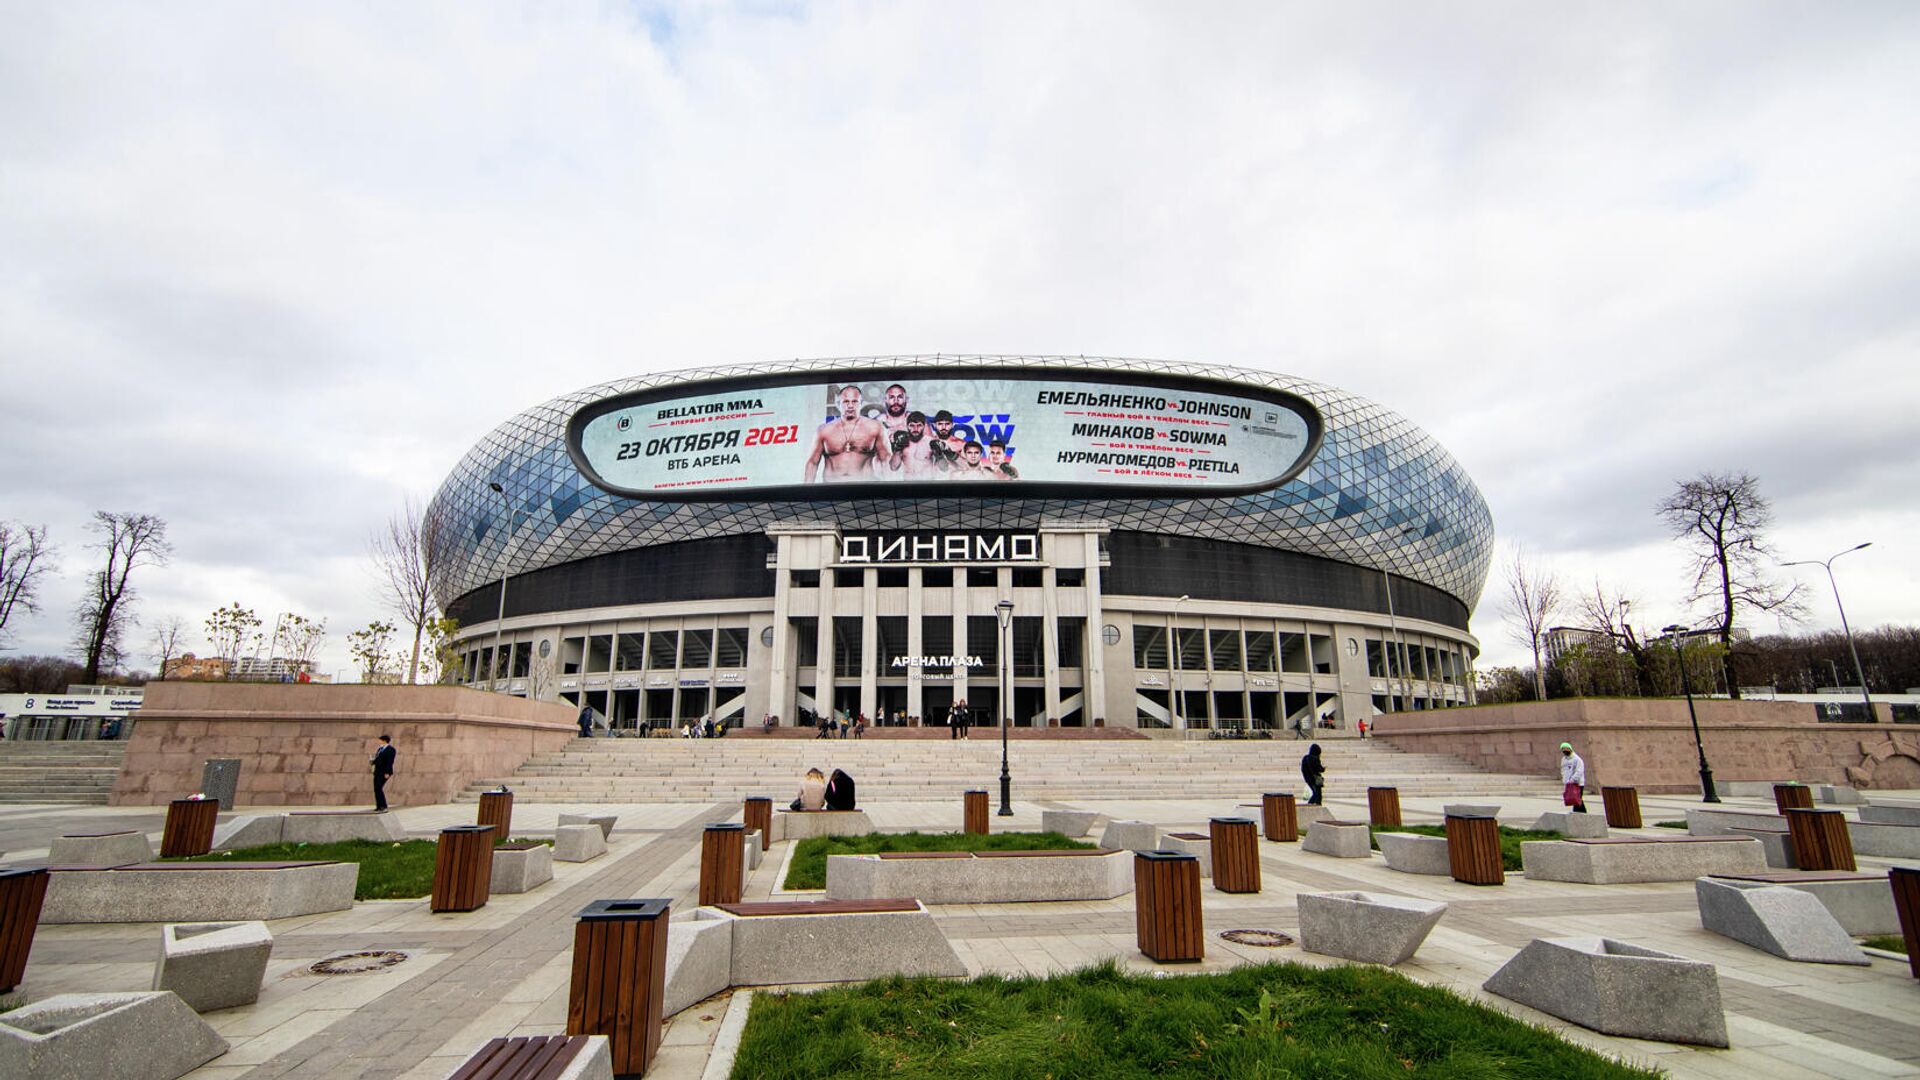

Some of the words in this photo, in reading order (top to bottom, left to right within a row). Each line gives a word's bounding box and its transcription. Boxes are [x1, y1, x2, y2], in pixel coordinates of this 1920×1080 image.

[657, 403, 724, 420] BELLATOR
[727, 399, 763, 412] MMA
[1037, 391, 1166, 411] ЕМЕЛЬЯНЕНКО
[1177, 400, 1251, 420] JOHNSON
[715, 413, 747, 421] РОССИИ
[616, 441, 642, 461] 23
[645, 430, 740, 457] ОКТЯБРЯ
[744, 425, 799, 447] 2021
[1072, 423, 1155, 440] МИНАКОВ
[1170, 430, 1227, 446] SOWMA
[667, 459, 689, 470] ВТБ
[692, 453, 741, 469] АРЕНА
[1057, 451, 1176, 470] НУРМАГОМЕДОВ
[1188, 459, 1240, 474] PIETILA
[840, 535, 1037, 561] ДИНАМО
[891, 655, 938, 667] АРЕНА
[940, 655, 984, 667] ПЛАЗА
[25, 698, 35, 709] 8
